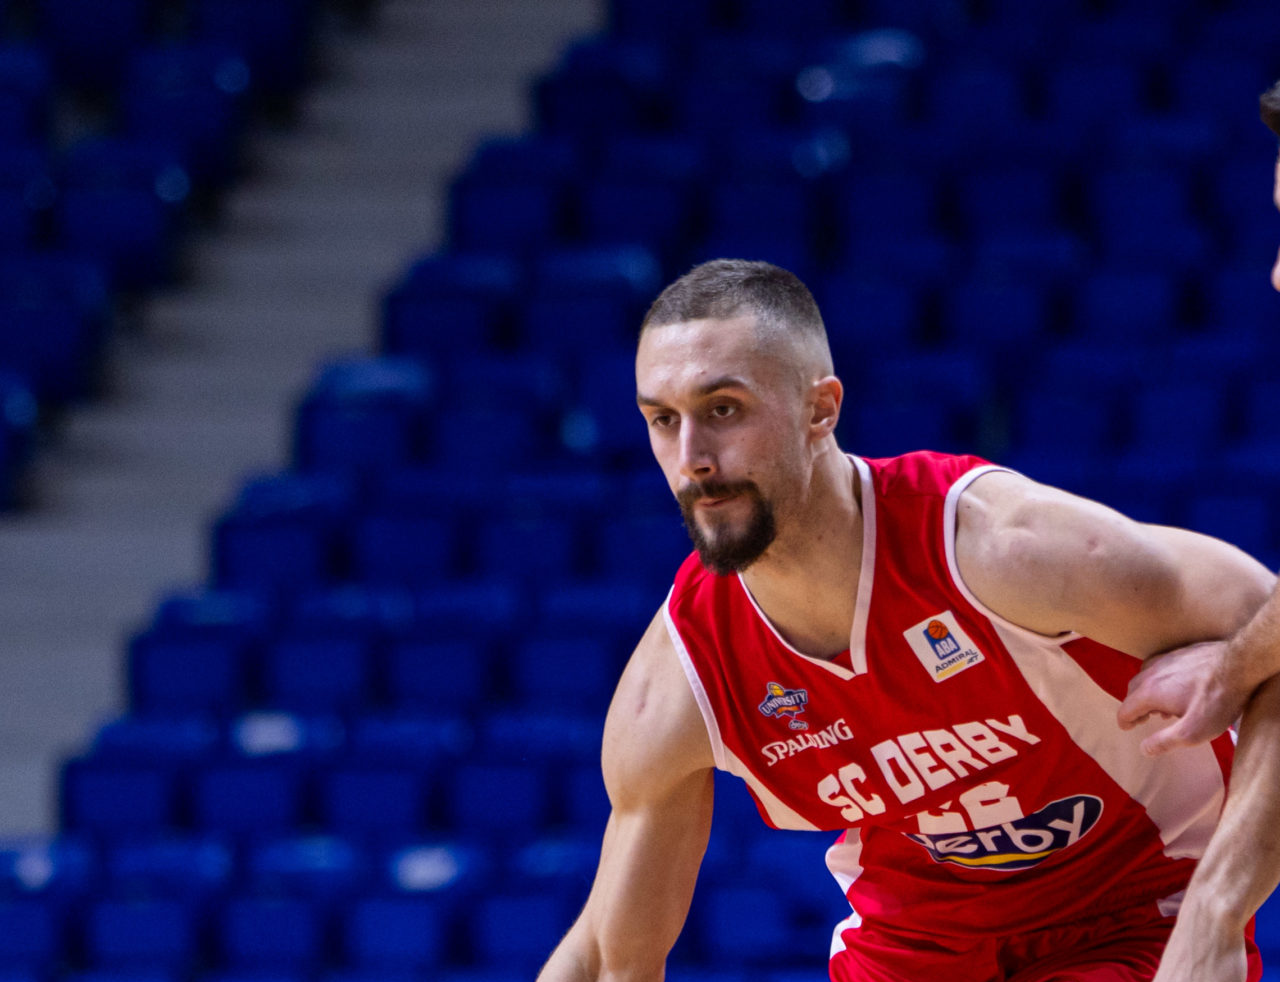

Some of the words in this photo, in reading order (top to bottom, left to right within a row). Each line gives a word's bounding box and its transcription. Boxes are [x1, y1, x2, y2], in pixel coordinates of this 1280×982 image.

[934, 636, 959, 658] ABA
[935, 648, 979, 673] ADMIRAL
[817, 763, 887, 822] SC
[870, 714, 1042, 805] DERBY
[914, 800, 1085, 856] erby
